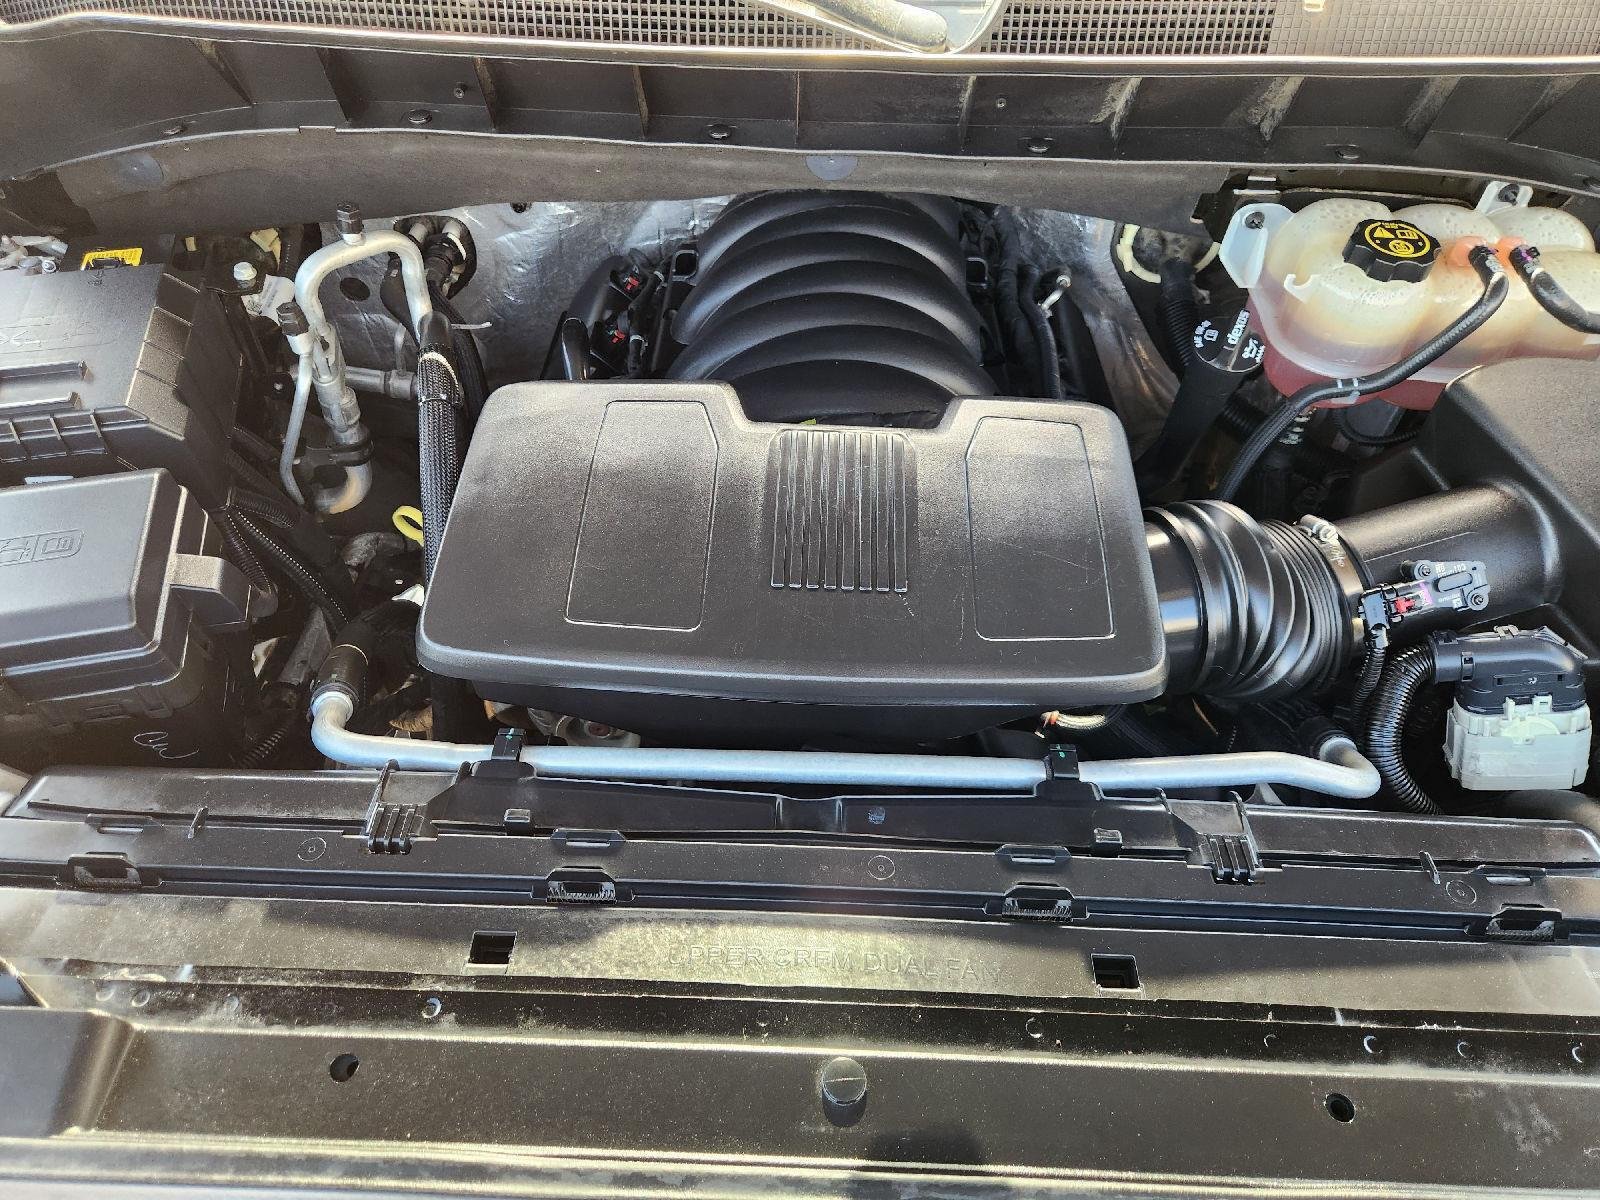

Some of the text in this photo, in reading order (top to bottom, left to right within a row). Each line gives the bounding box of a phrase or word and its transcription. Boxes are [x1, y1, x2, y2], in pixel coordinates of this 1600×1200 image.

[1227, 309, 1250, 345] dexos
[668, 945, 1001, 984] UPPER CRFM DUAL FAN
